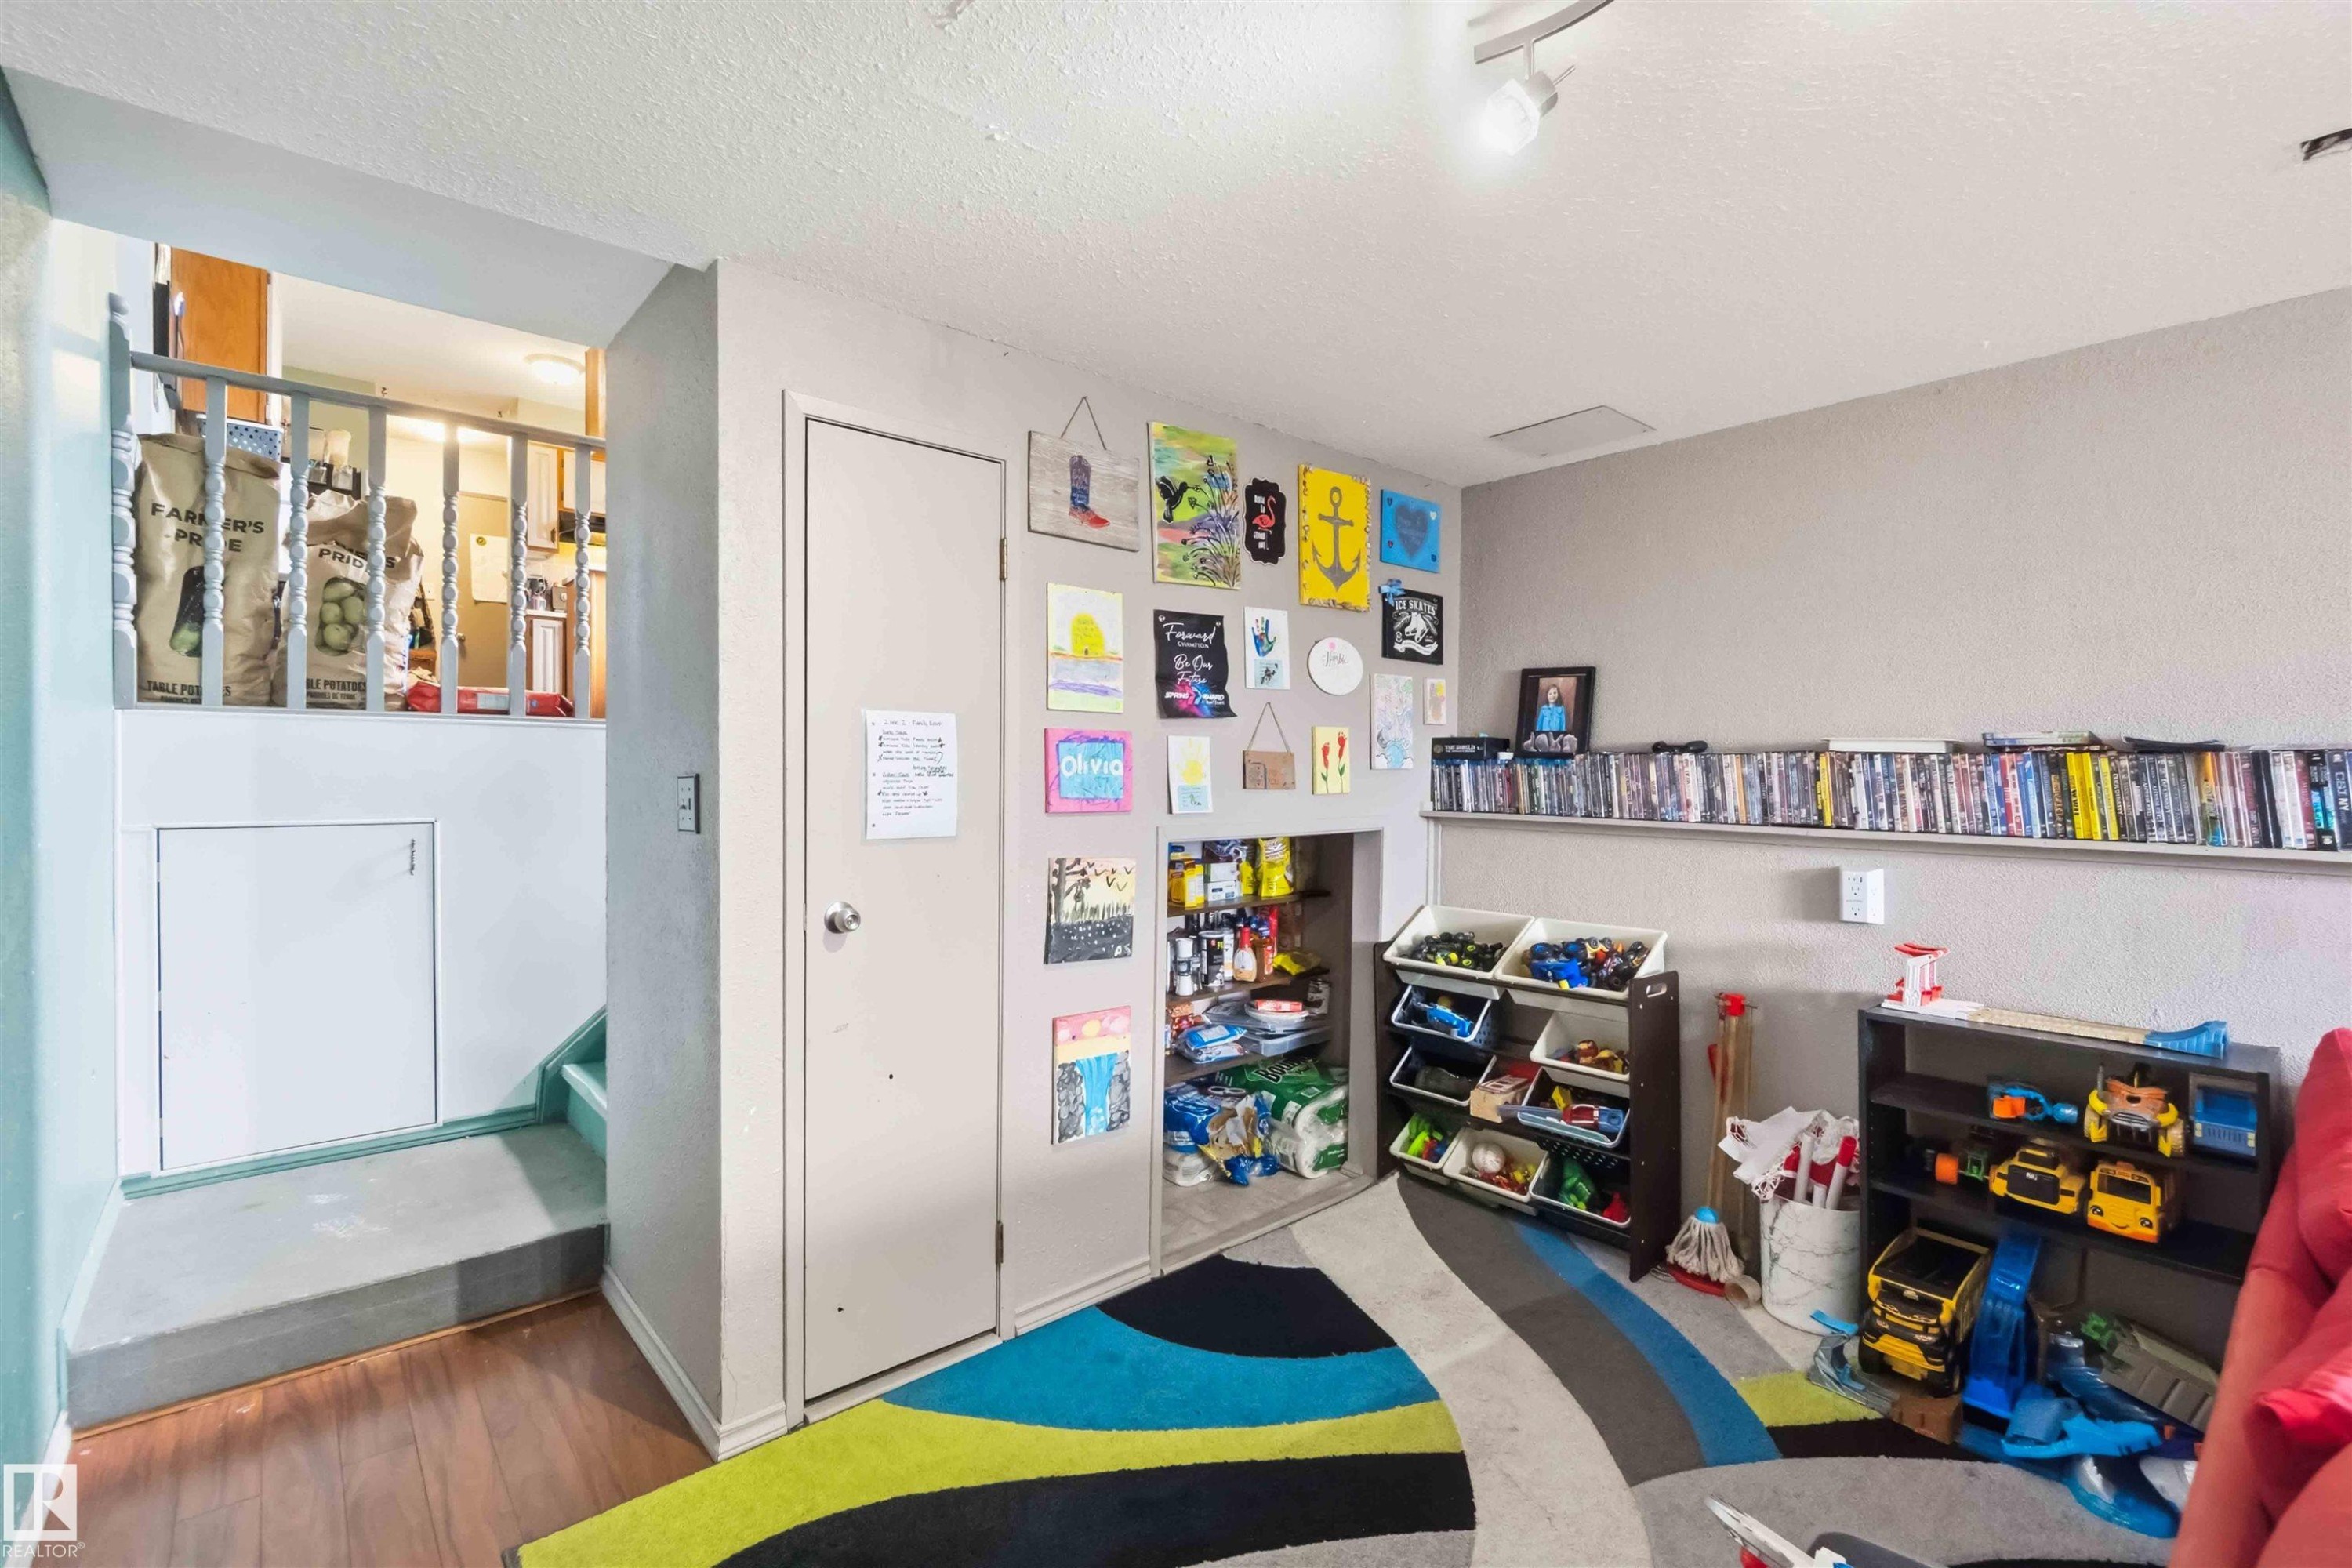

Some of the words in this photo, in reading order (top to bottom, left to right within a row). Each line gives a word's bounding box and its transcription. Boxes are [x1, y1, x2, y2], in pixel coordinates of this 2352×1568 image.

[174, 528, 243, 553] PRE
[318, 548, 364, 568] PRID
[1396, 600, 1407, 611] ICE
[1409, 600, 1436, 615] SKATES
[1163, 622, 1216, 644] Forward
[1174, 654, 1191, 670] Be
[1192, 654, 1213, 671] Our
[147, 680, 178, 695] TABLE
[180, 684, 231, 696] POTS
[306, 678, 321, 690] BLE
[1060, 753, 1124, 777] Olivia
[2339, 798, 2350, 811] NY
